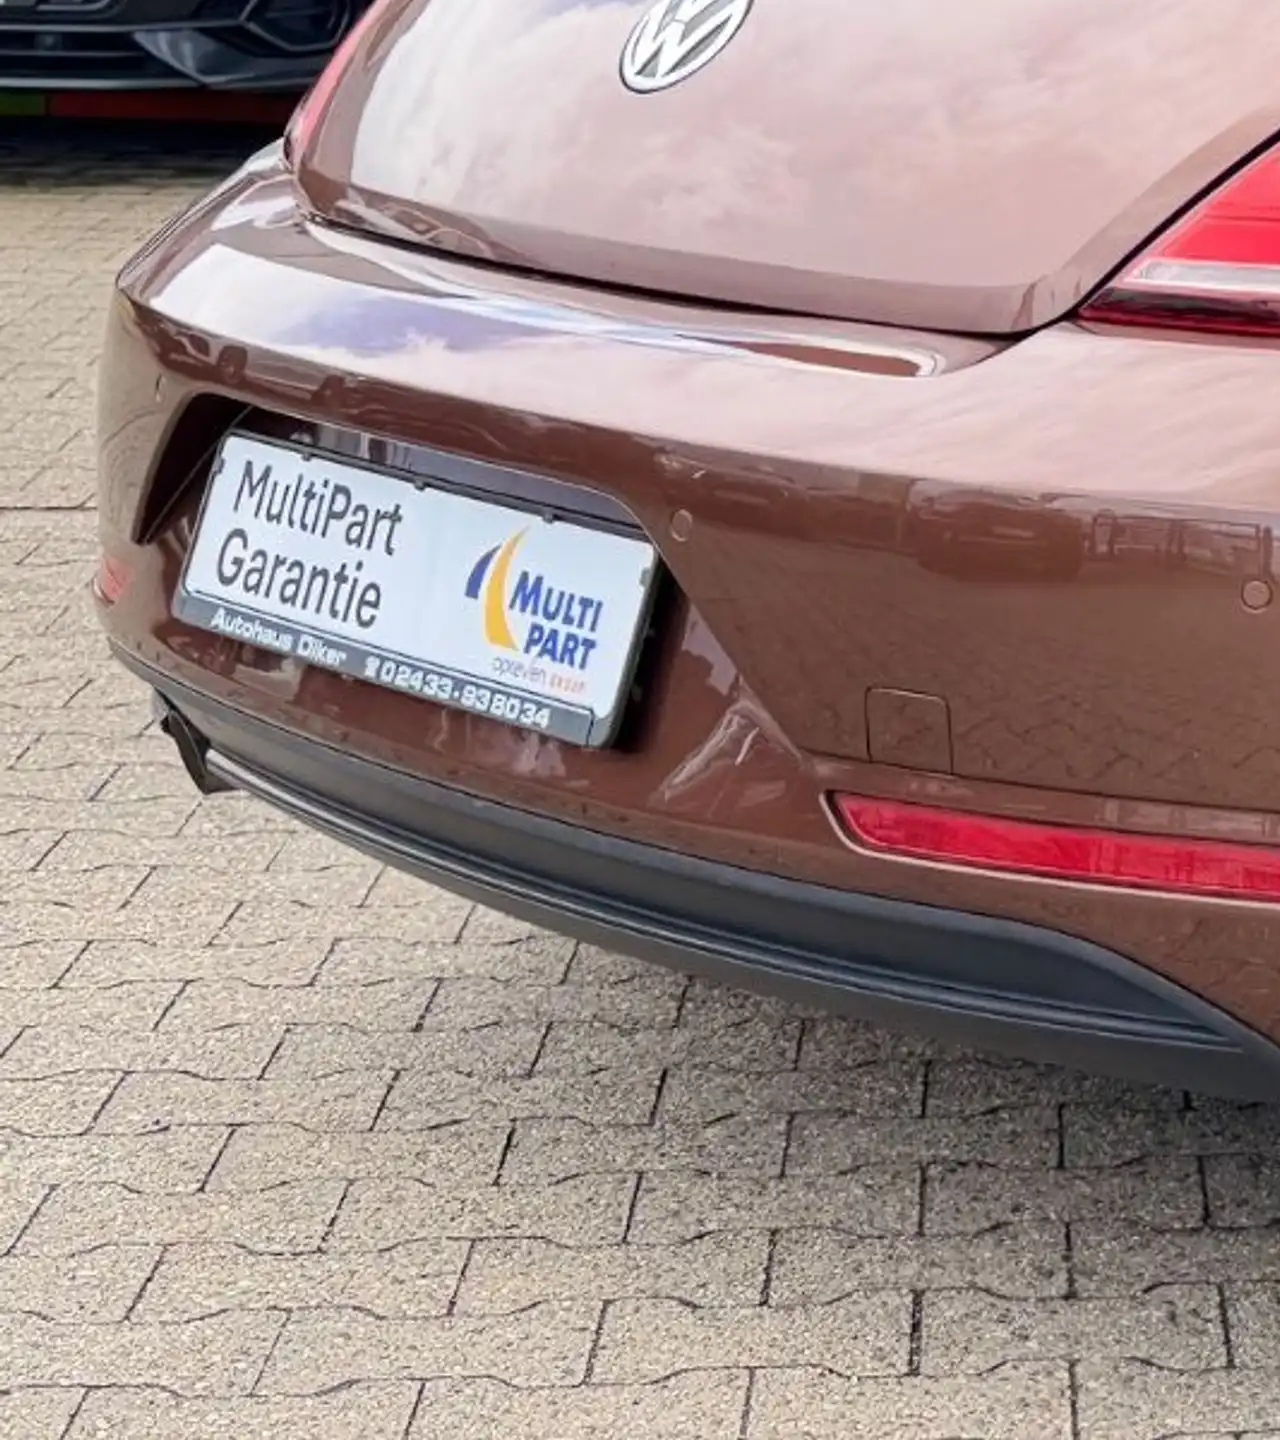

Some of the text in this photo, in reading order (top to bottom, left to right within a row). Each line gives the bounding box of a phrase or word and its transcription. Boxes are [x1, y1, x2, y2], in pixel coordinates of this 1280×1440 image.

[232, 459, 404, 557] MultiPart
[216, 527, 383, 630] Garantie
[508, 569, 605, 633] MULTI
[210, 606, 294, 652] Autohaus
[296, 633, 348, 667] Diker
[522, 621, 598, 671] PART
